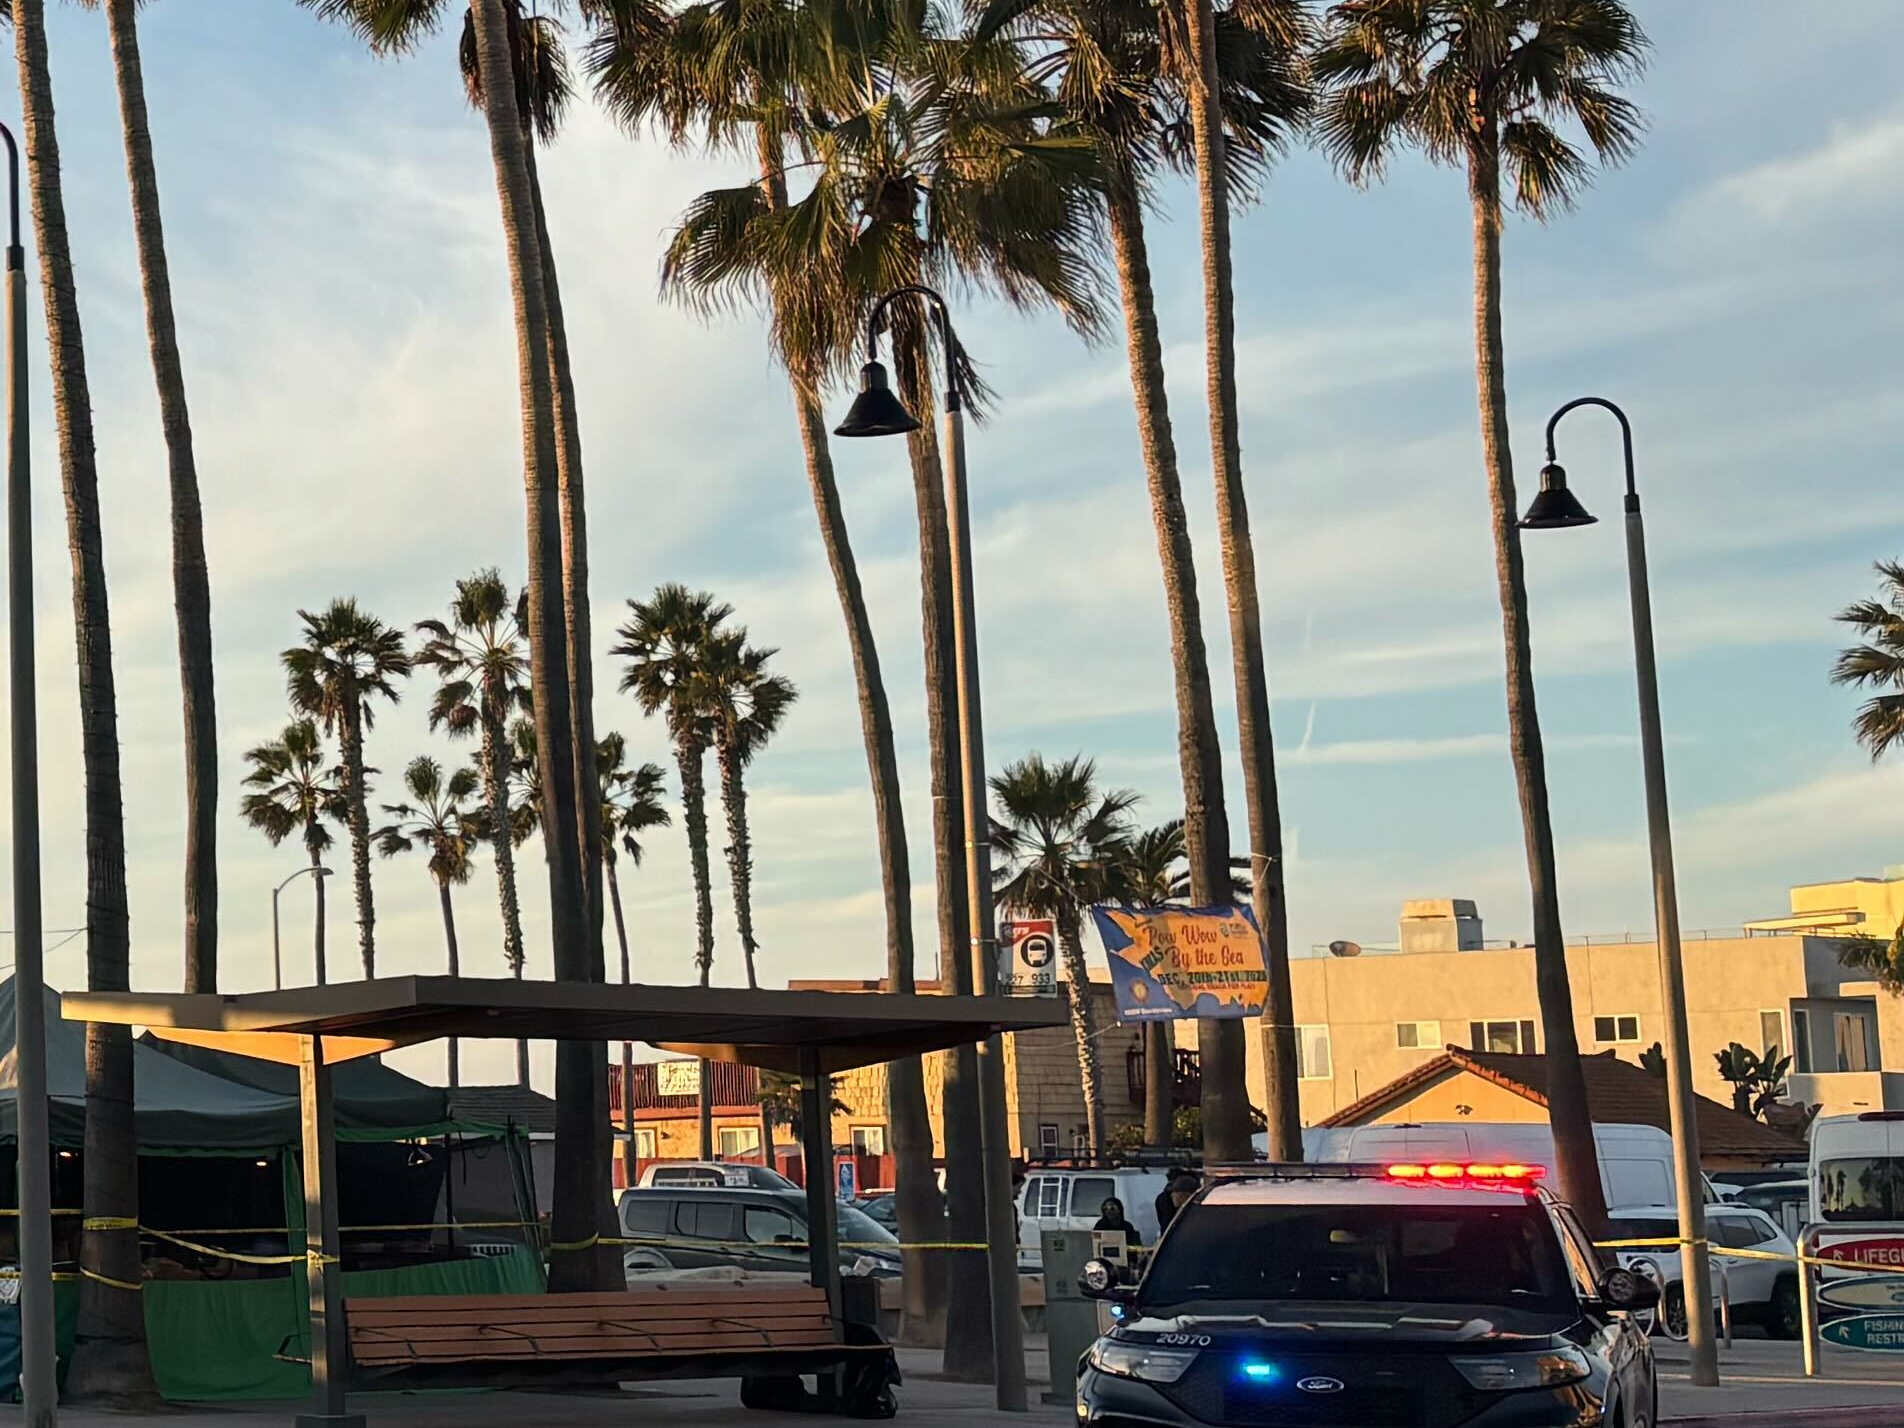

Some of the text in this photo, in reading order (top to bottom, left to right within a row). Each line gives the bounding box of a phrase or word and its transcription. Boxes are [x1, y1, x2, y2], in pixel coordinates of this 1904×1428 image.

[1181, 925, 1217, 943] Wow
[1165, 946, 1190, 971] By
[1196, 948, 1215, 965] the
[1221, 945, 1244, 966] Sea
[1156, 1333, 1211, 1346] 20970
